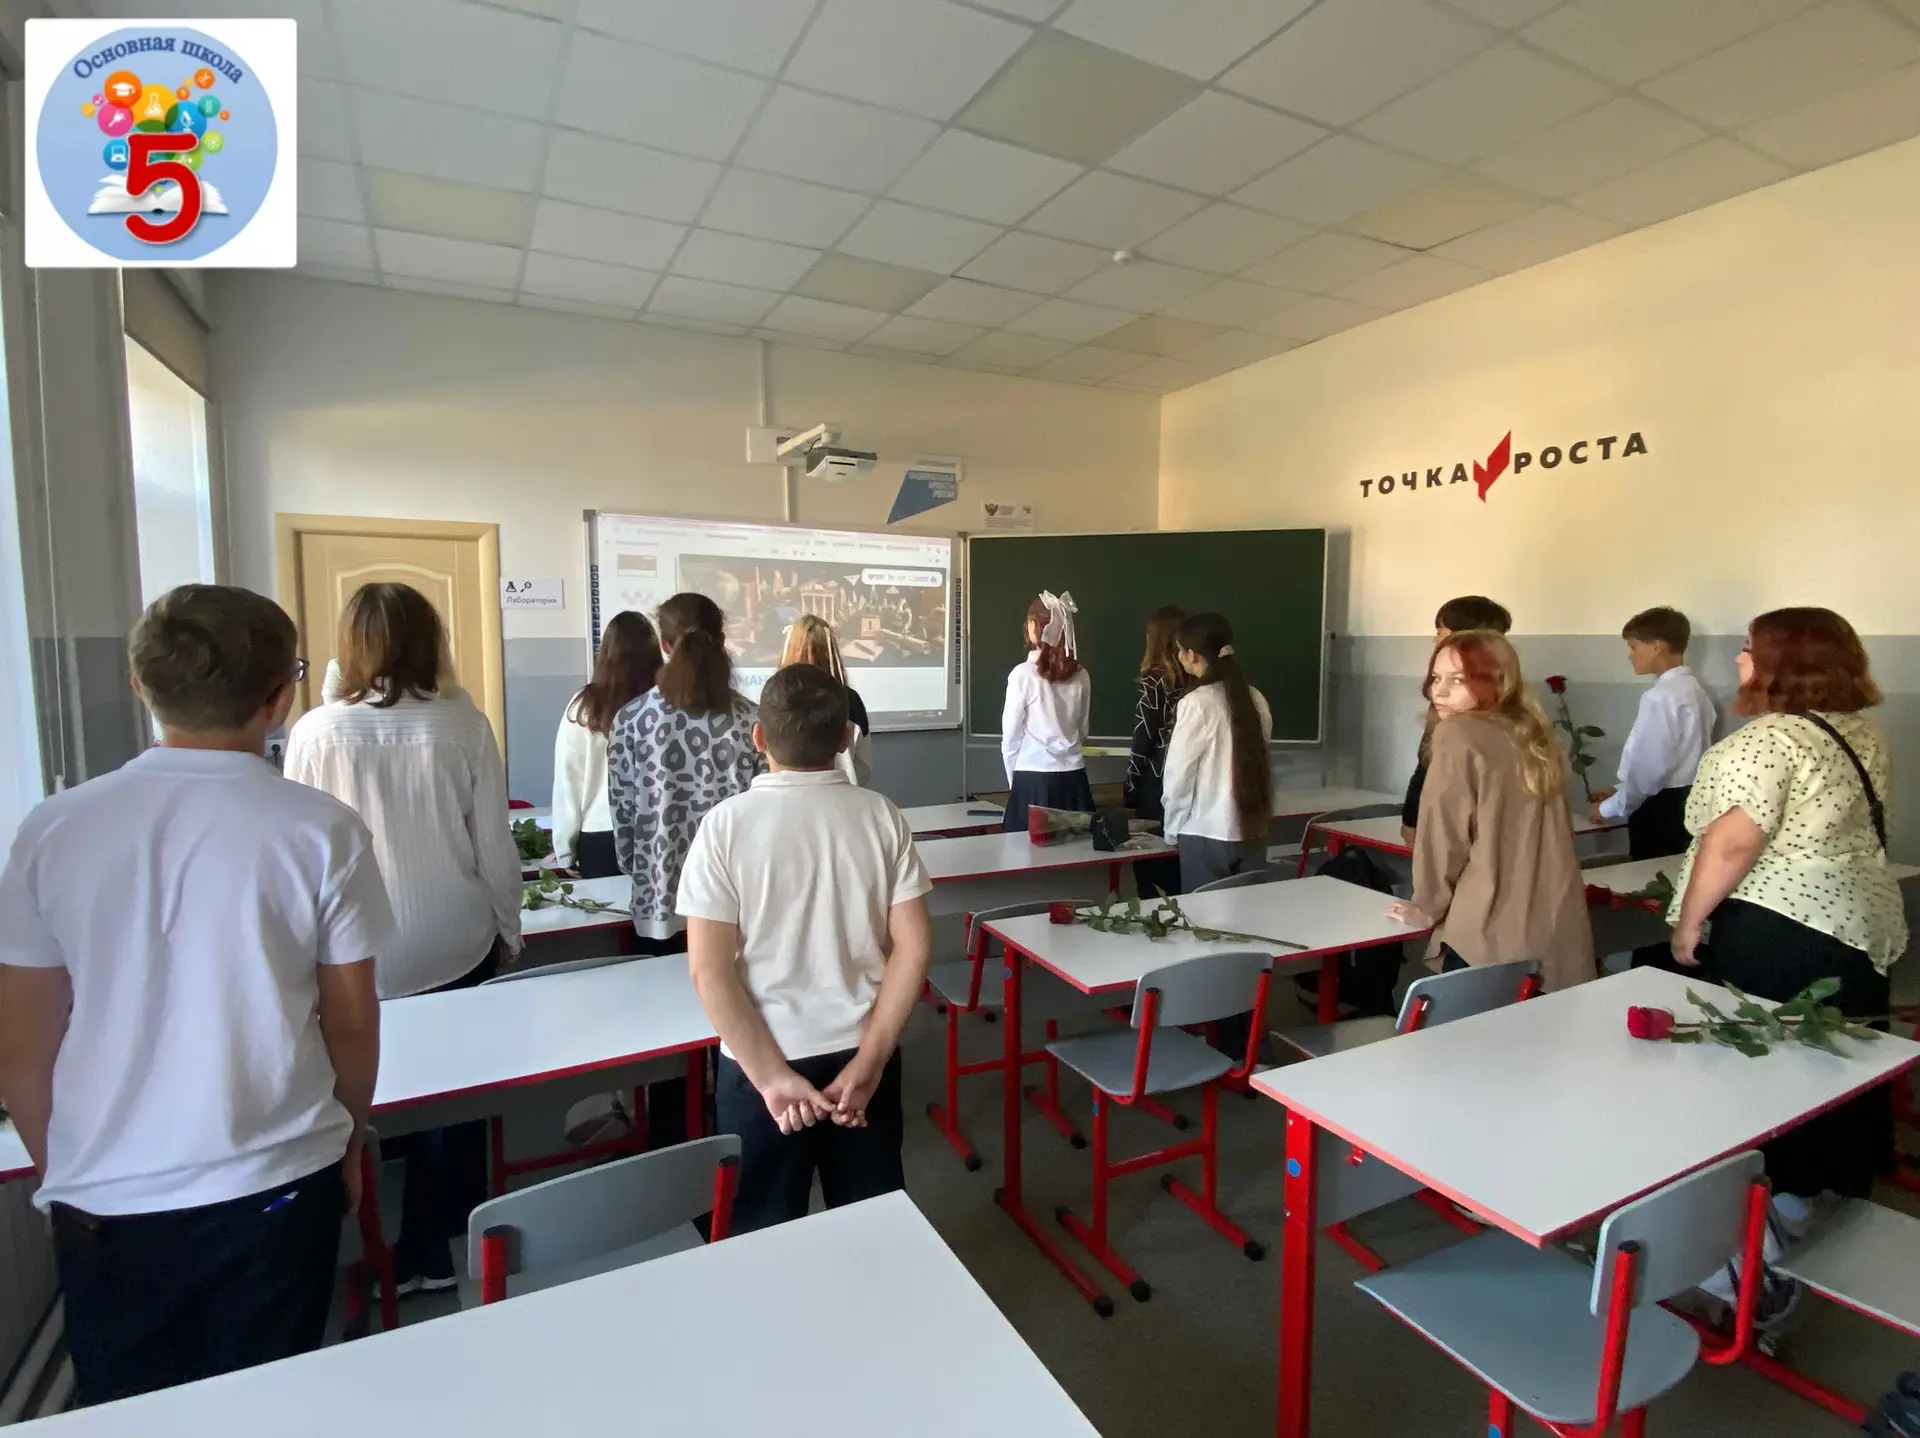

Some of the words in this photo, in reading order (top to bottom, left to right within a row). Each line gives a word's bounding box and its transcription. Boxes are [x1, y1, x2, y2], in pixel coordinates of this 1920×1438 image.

[1360, 463, 1469, 498] ТОЧКА
[1514, 432, 1648, 475] РОСТА
[506, 596, 557, 605] Лаборатория
